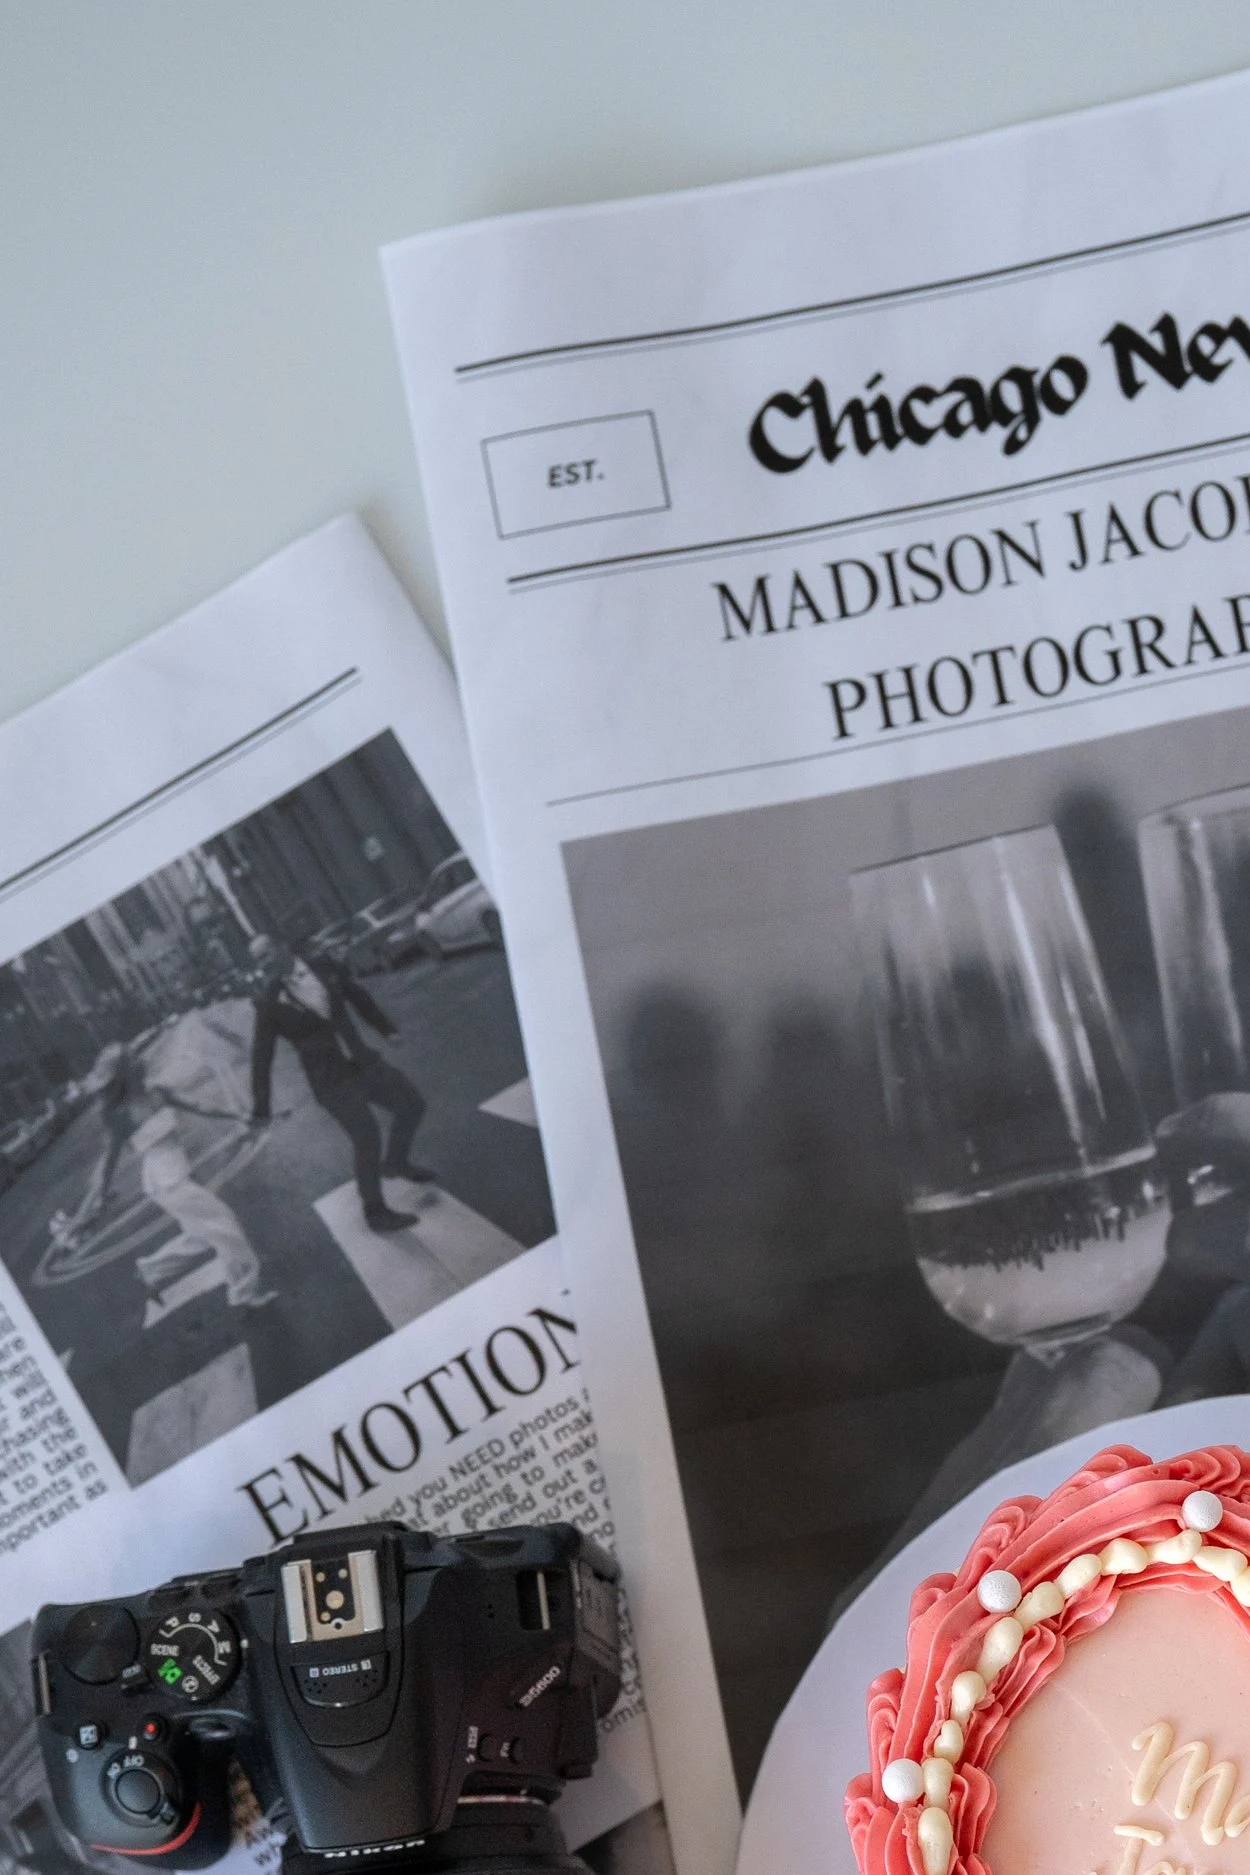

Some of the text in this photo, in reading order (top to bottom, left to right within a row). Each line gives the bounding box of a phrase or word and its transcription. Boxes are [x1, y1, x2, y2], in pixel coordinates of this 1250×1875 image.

[748, 355, 1089, 474] Chicago
[548, 460, 603, 488] EST.
[714, 522, 1044, 640] MADISON
[322, 1663, 358, 1676] STEREO
